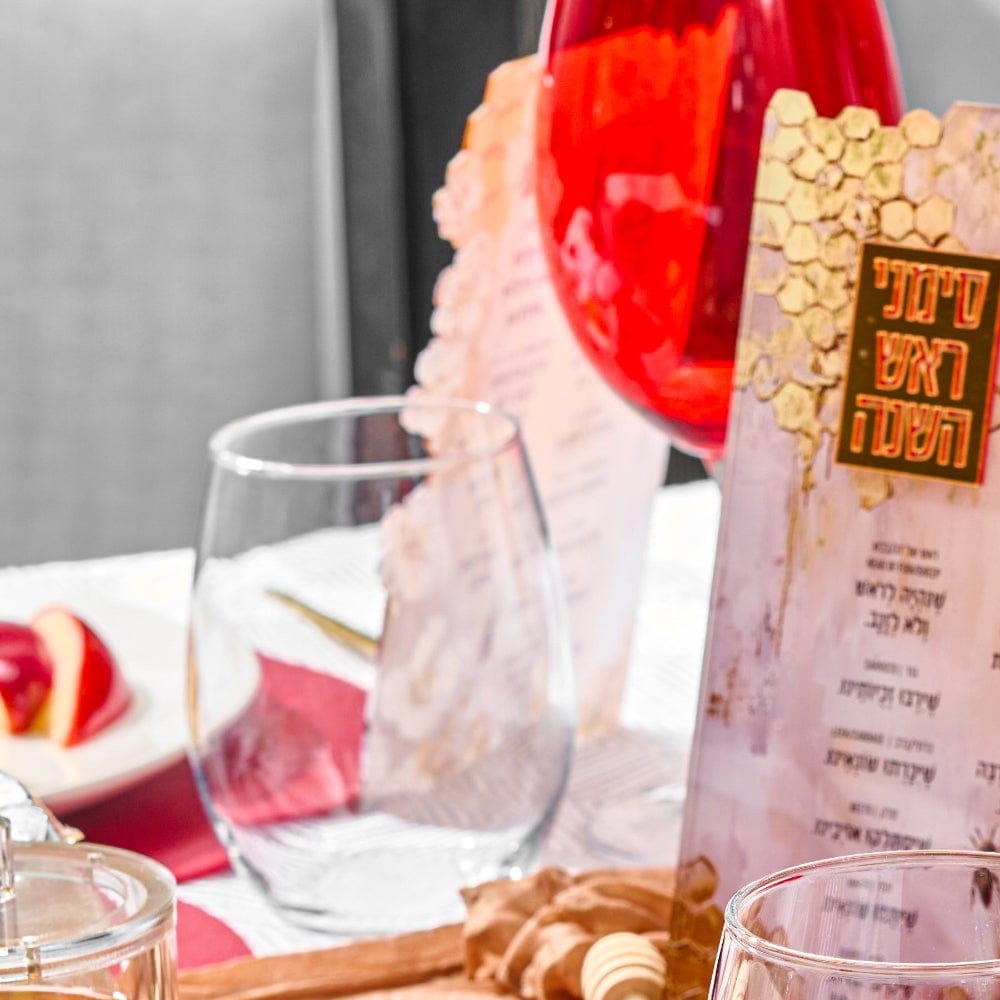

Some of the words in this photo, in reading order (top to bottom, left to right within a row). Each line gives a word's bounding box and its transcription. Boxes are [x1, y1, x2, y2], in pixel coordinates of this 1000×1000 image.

[872, 256, 991, 330] סימני
[874, 330, 970, 400] ראש
[850, 393, 974, 469] השנה
